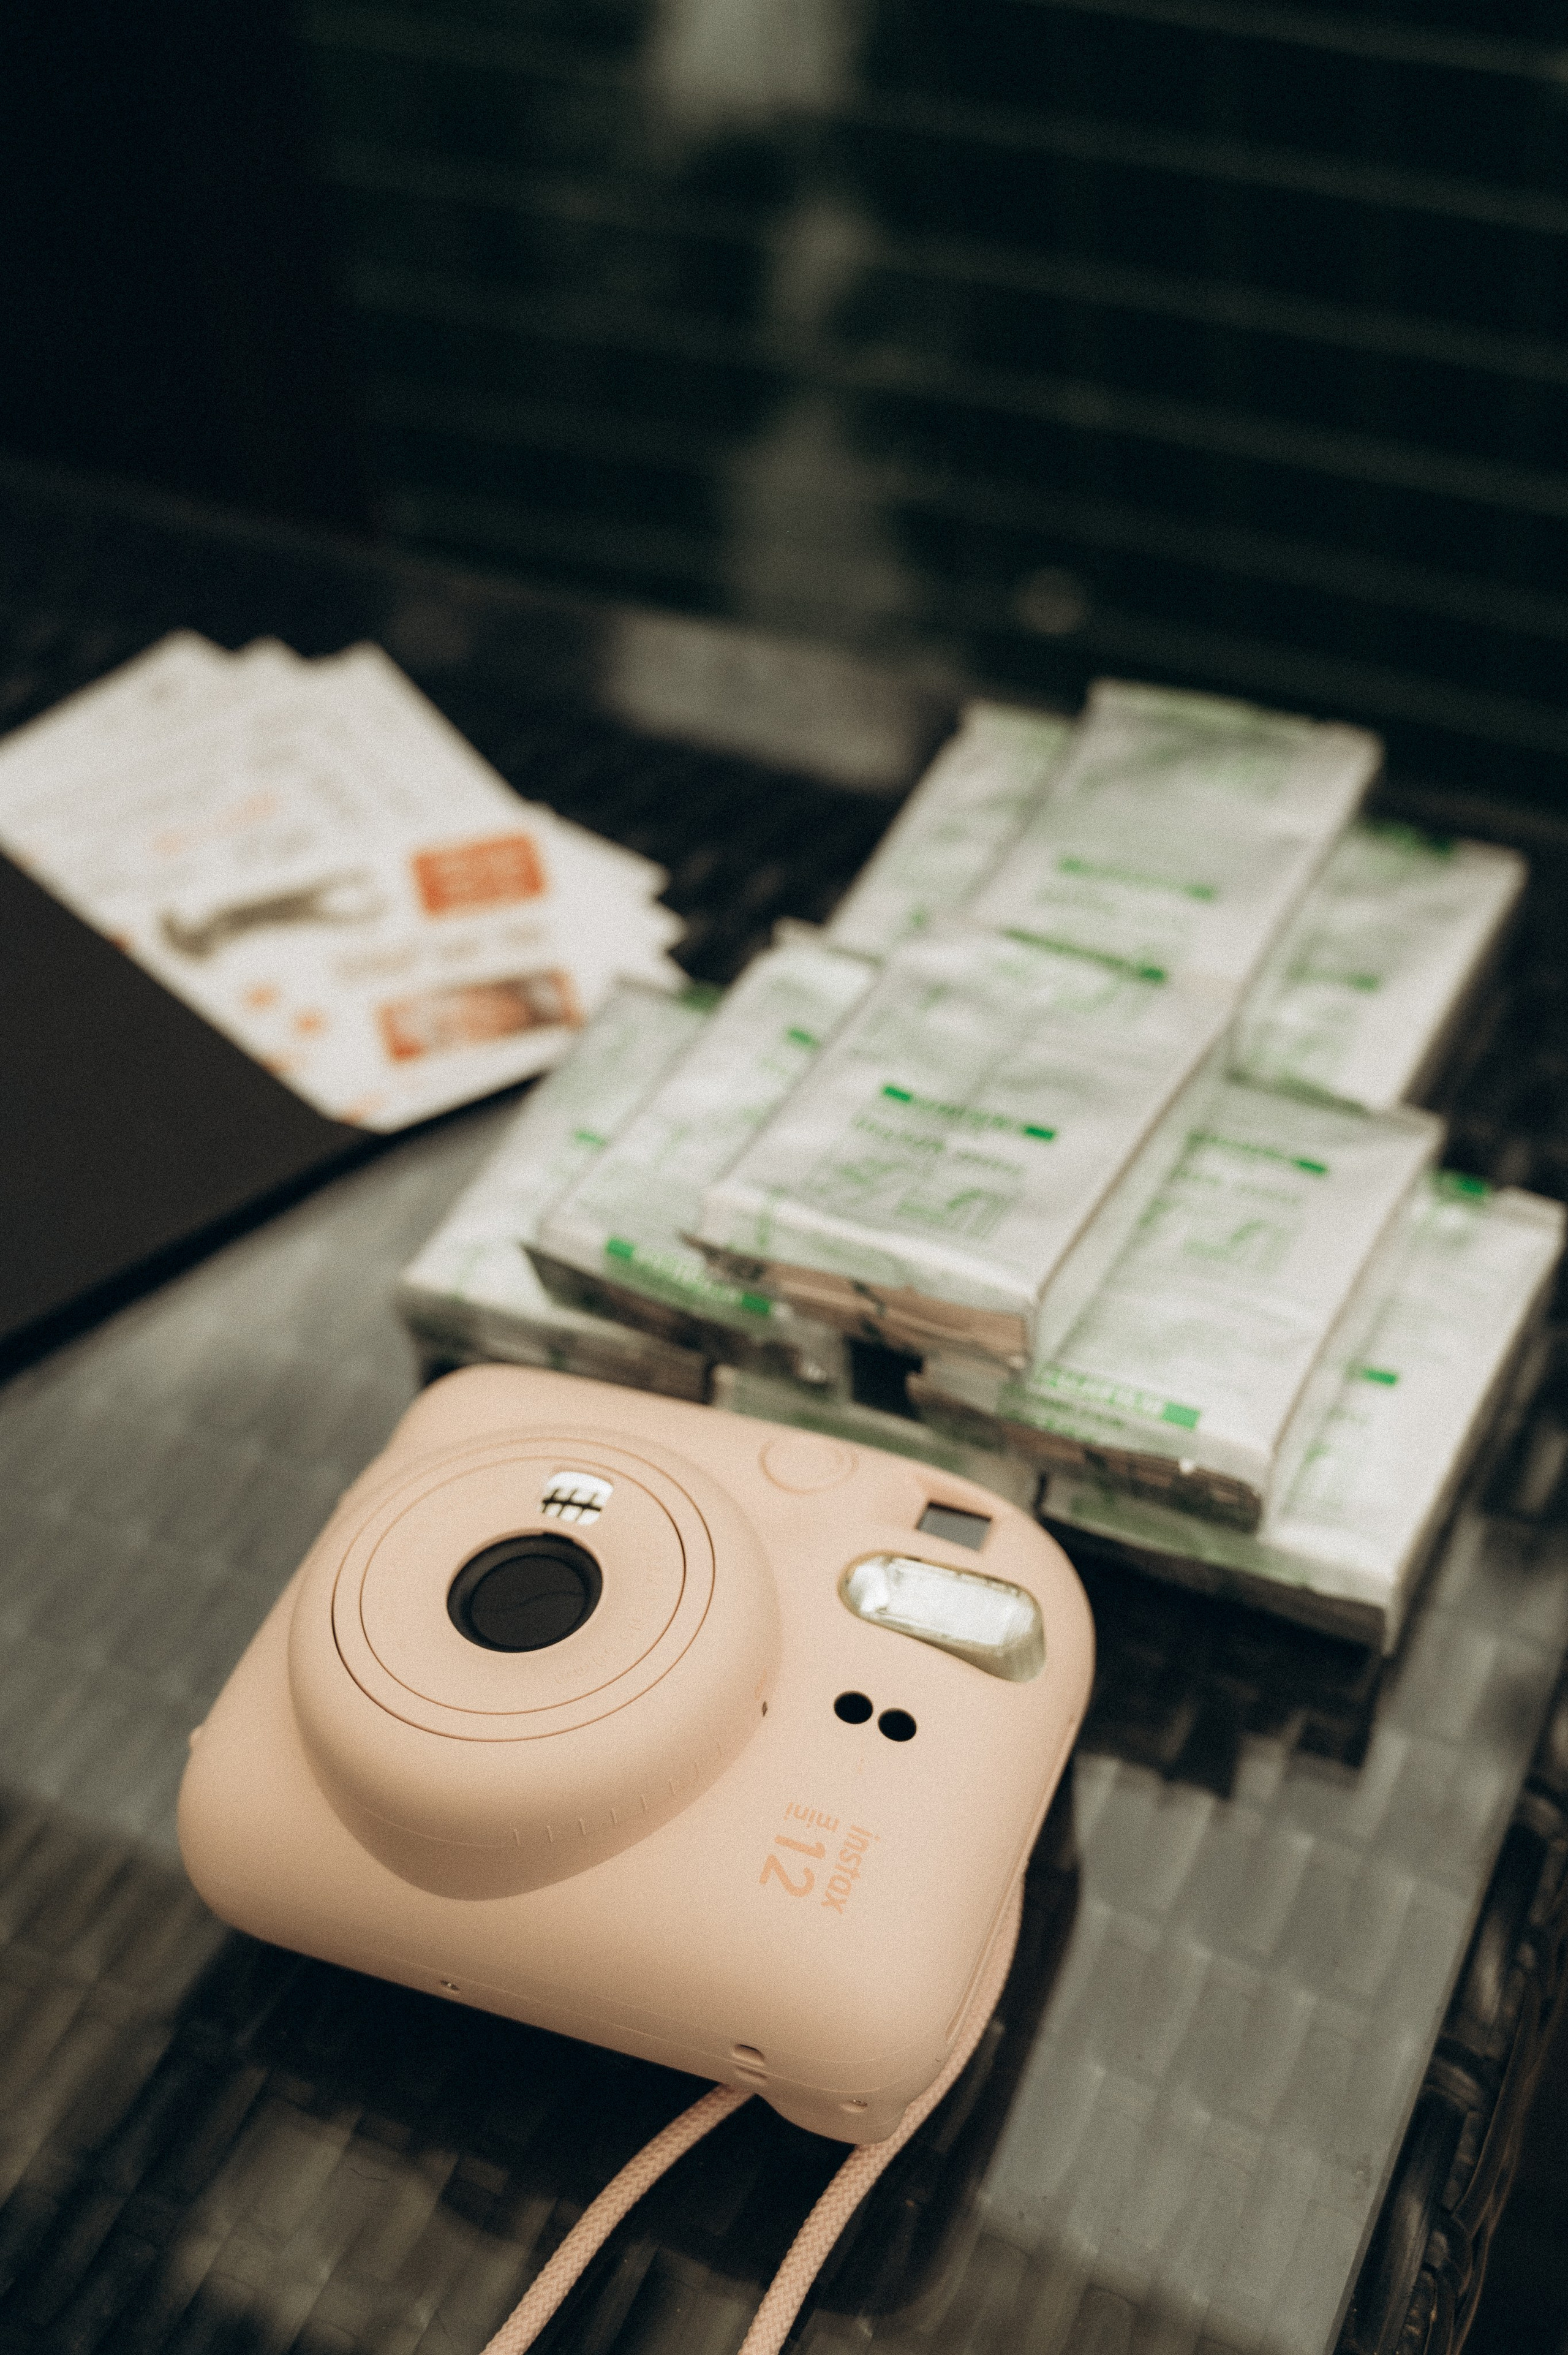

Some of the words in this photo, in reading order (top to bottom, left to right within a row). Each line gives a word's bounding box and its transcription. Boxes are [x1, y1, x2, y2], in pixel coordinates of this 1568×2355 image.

[782, 1802, 840, 1832] mini
[760, 1835, 826, 1897] 12
[821, 1824, 881, 1914] instax
